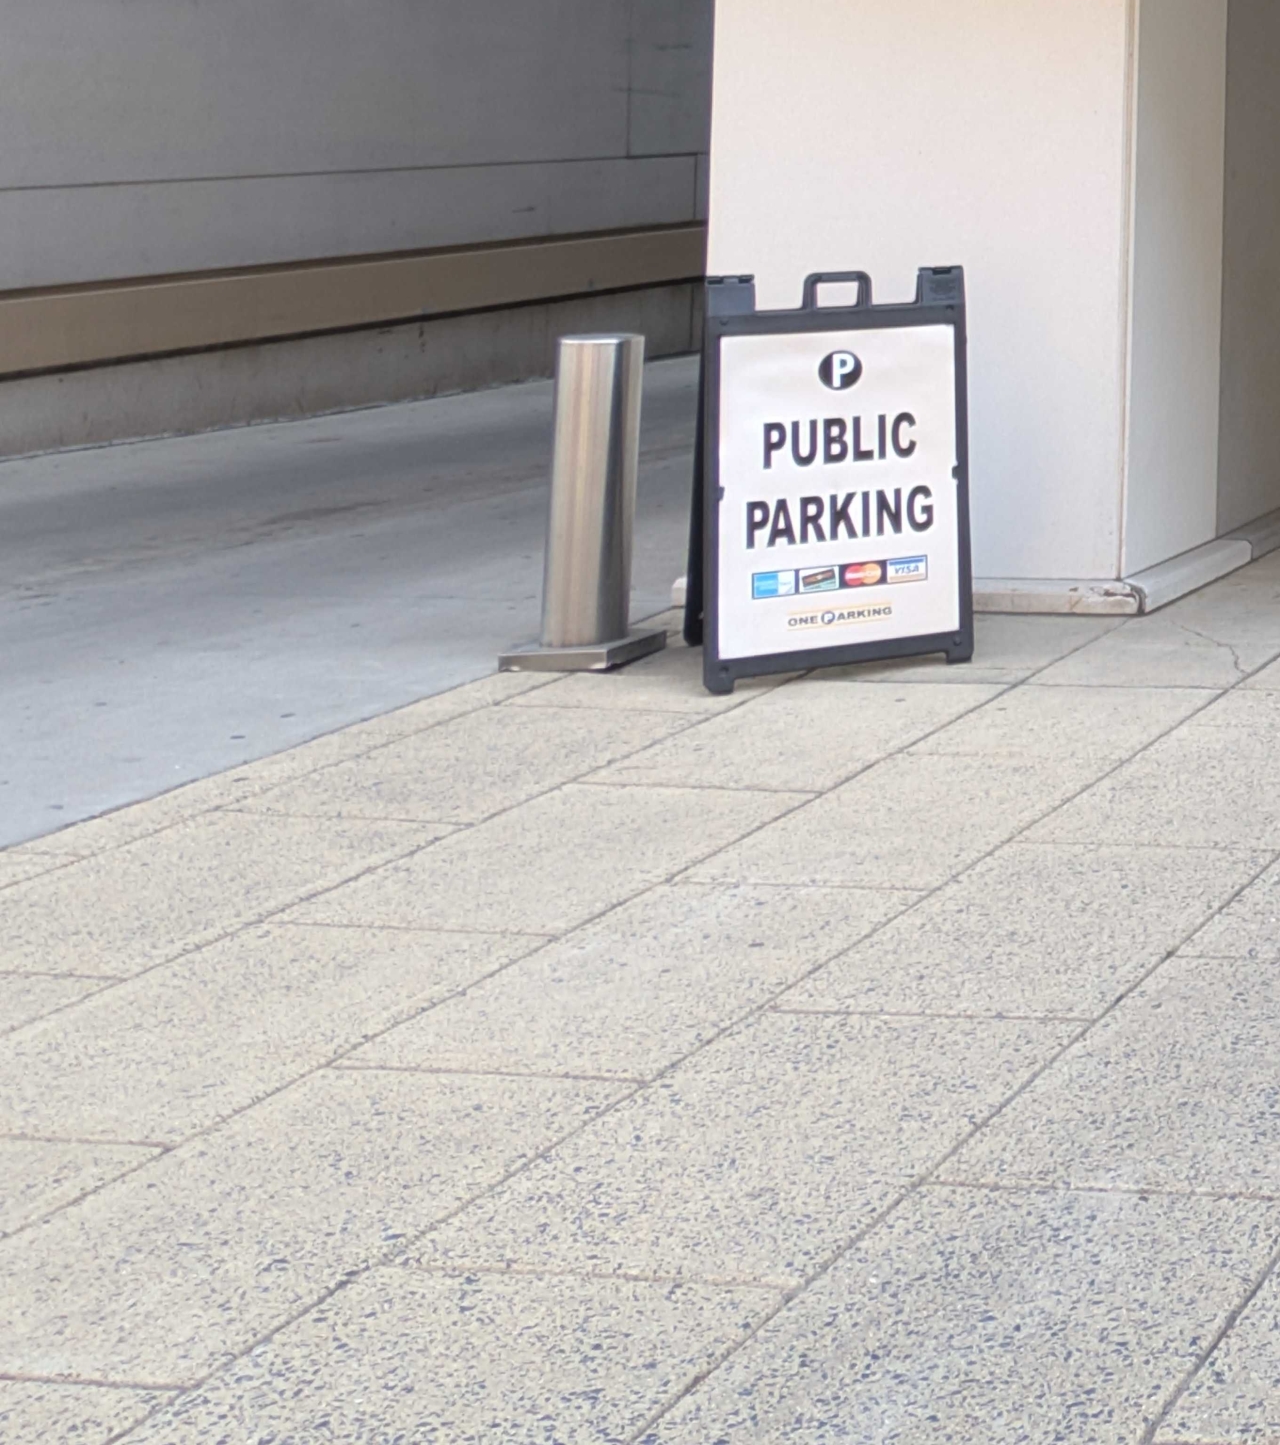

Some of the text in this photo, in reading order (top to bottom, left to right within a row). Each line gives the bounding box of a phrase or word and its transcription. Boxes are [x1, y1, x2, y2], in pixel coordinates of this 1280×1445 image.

[762, 412, 918, 470] PUBLIC
[745, 485, 934, 550] PARKING
[894, 564, 920, 575] VISA
[787, 605, 893, 627] ONE PARKING
